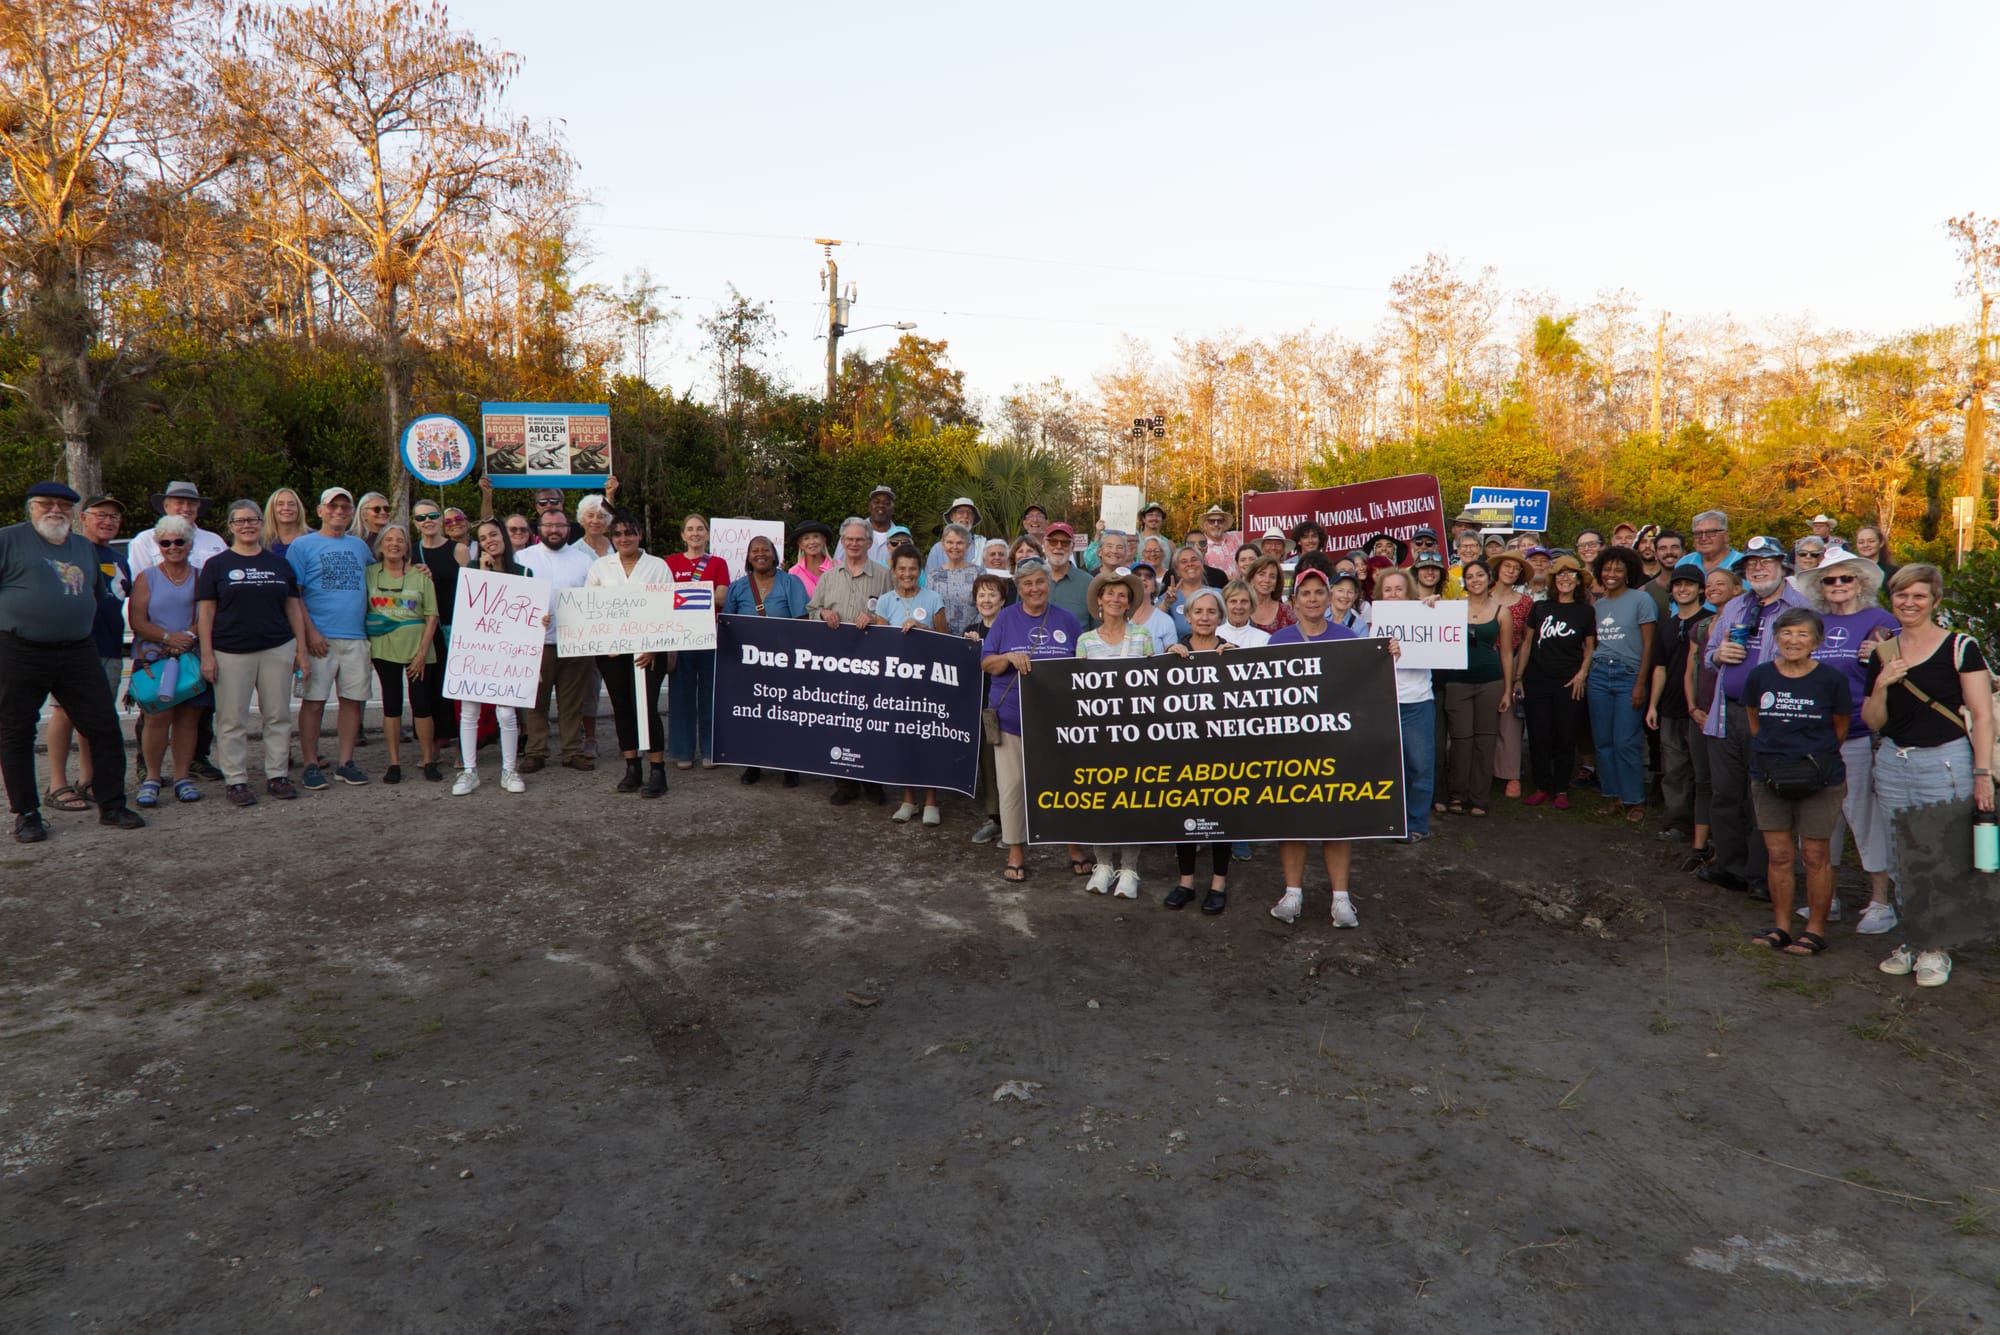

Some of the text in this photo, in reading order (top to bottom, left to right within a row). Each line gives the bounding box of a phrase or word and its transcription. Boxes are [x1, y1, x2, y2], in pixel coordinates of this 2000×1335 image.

[487, 425, 524, 434] ABOLISH
[529, 425, 566, 434] ABOLISH
[537, 434, 560, 442] I.C.E.
[570, 426, 607, 434] ABOLISH
[1369, 495, 1435, 521] UN-AMERICAN
[1326, 522, 1429, 552] ALLIGAT ALCATR
[587, 592, 648, 610] HUSBAND
[585, 609, 631, 620] IS HERE
[475, 616, 504, 634] ARE
[588, 624, 613, 637] ARE
[1376, 624, 1462, 643] ABOLISH ICE
[451, 634, 495, 652] HUMAN
[608, 640, 635, 653] ARE
[641, 636, 680, 651] HUMAN
[448, 655, 534, 679] CRUEL AND
[742, 644, 960, 687] Due Process For All
[1072, 657, 1322, 690] NOT ON OUR WATCH
[447, 680, 528, 700] UNUSUAL
[753, 683, 950, 719] Stop abducting, detaining,
[1077, 685, 1319, 717] NOT IN OUR NATION
[1775, 703, 1803, 711] CIRCLE
[1776, 697, 1815, 706] WORKERS
[732, 704, 971, 744] and disappearing our neighbors
[1056, 712, 1352, 744] NOT TO OUR NEIGHBORS
[1073, 758, 1336, 785] STOP ICE ABDUCTIONS
[1038, 780, 1394, 810] CLOSE ALLIGATOR ALCATRAZ
